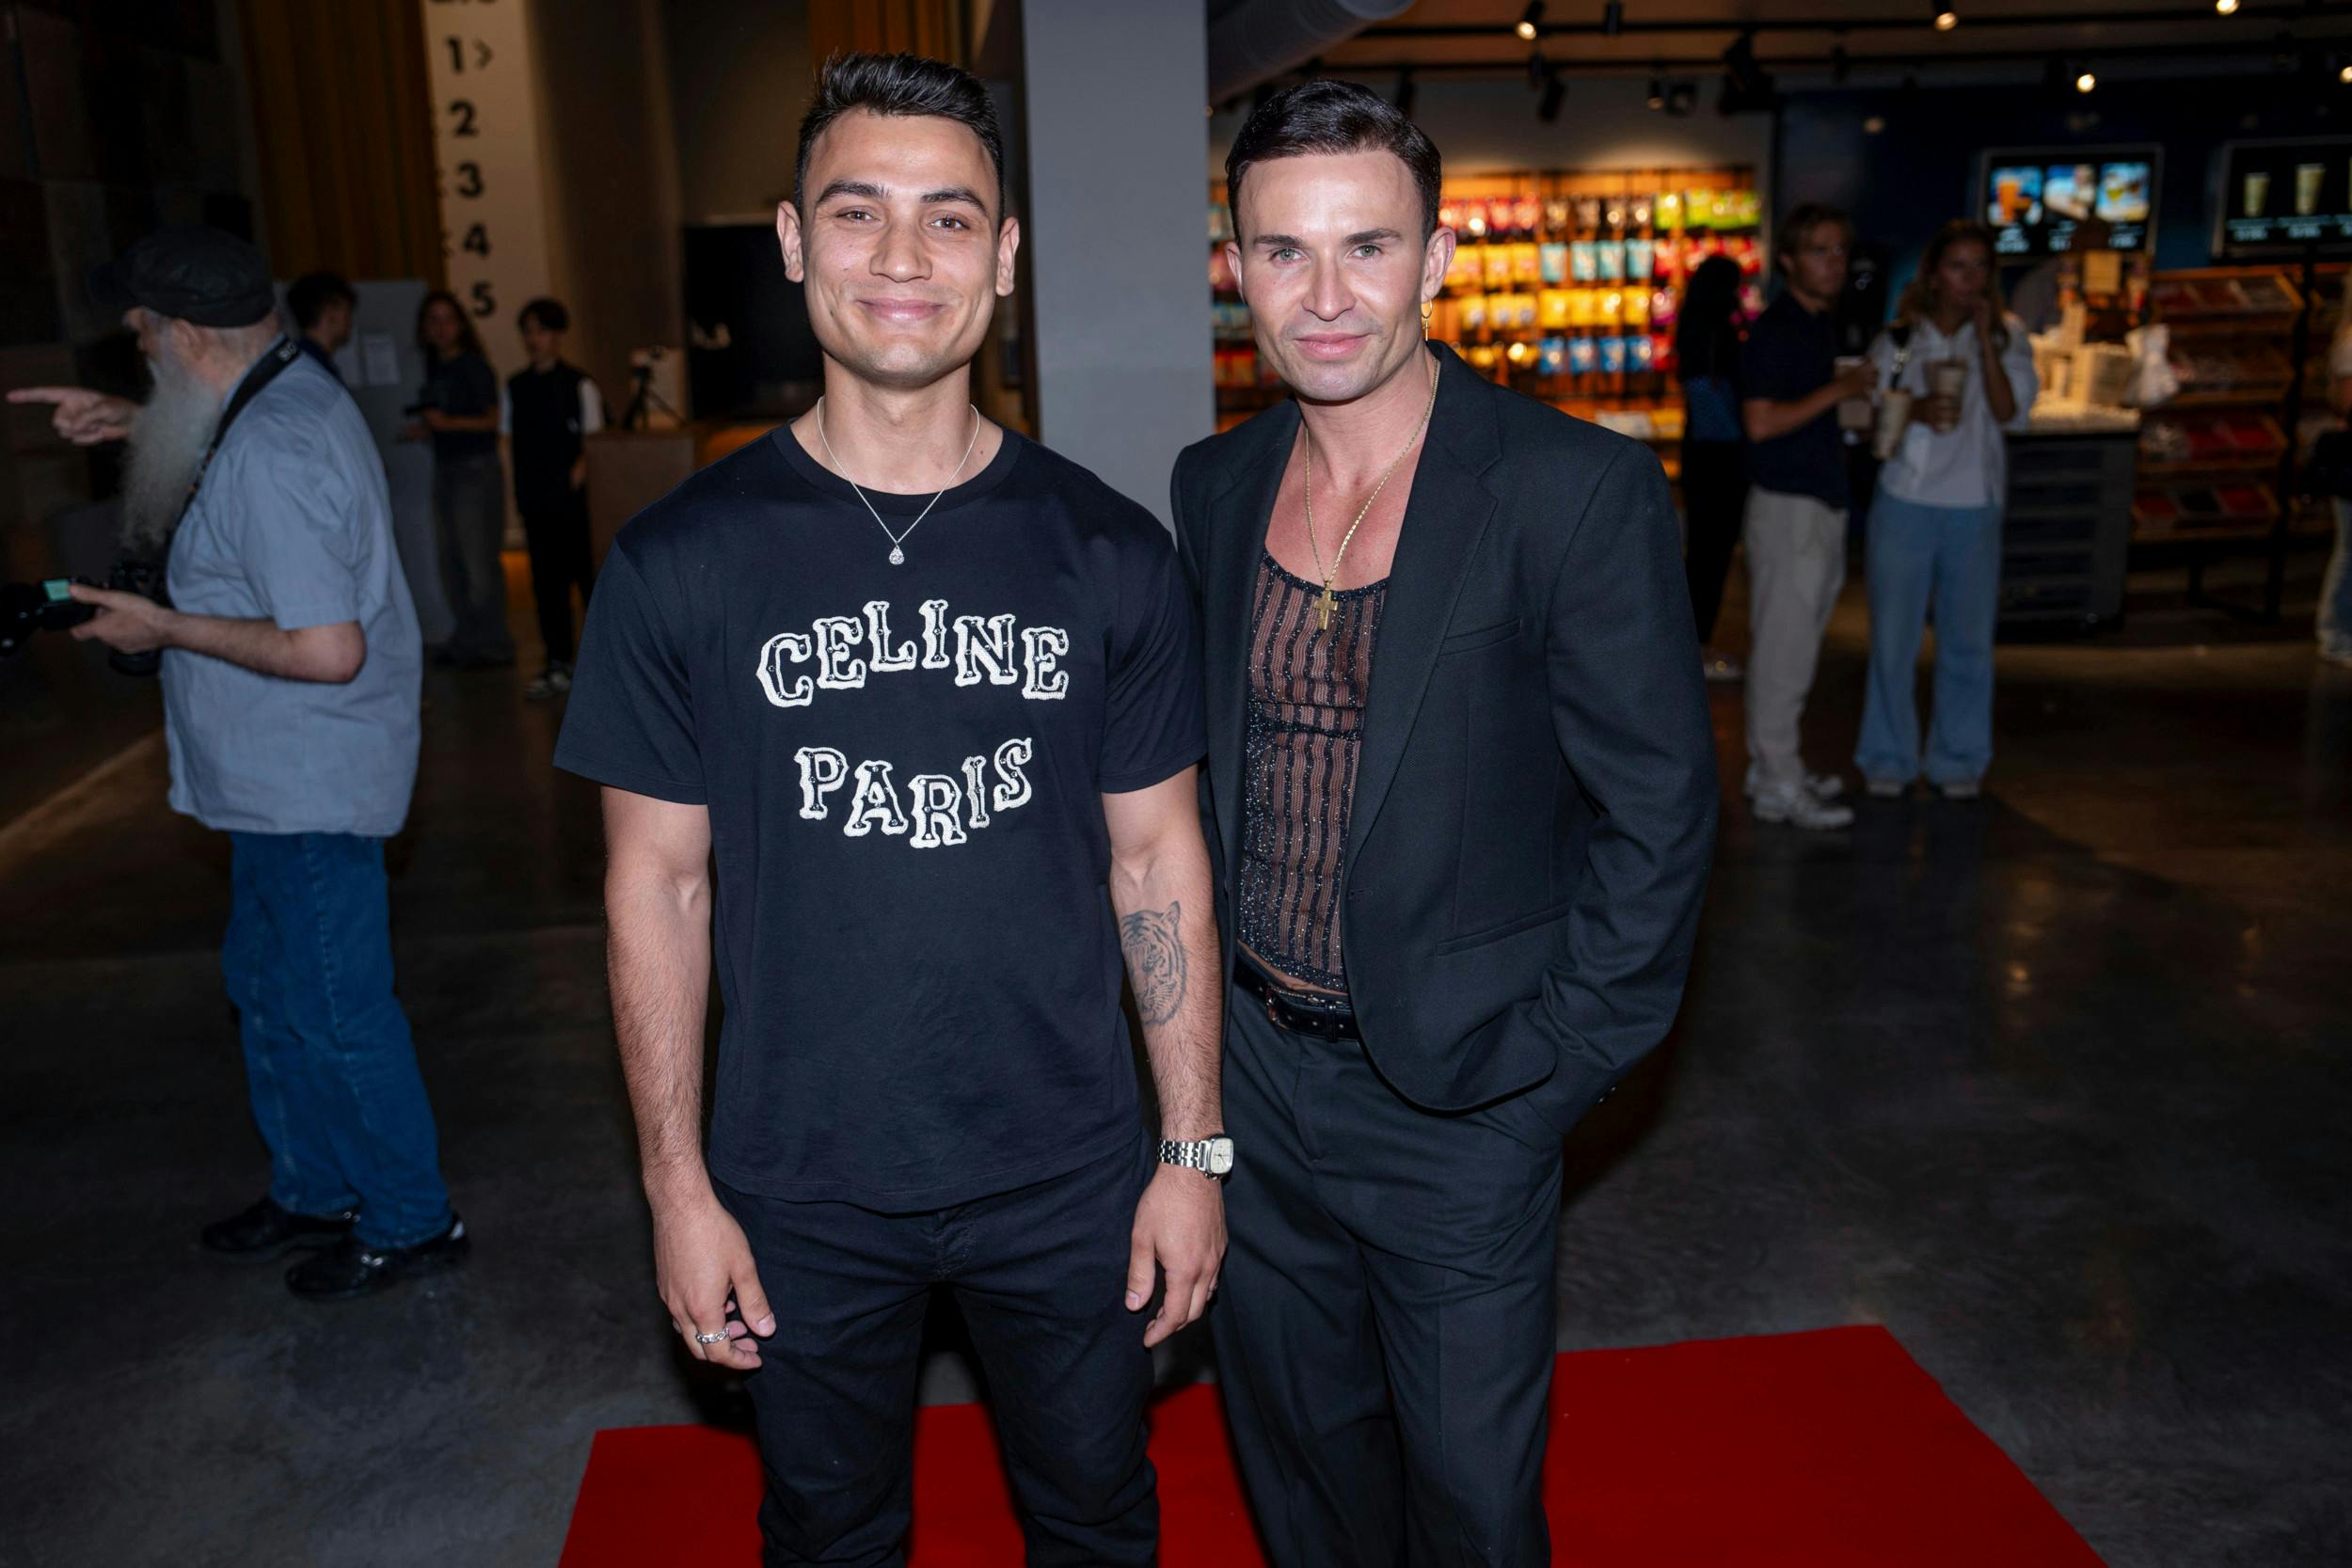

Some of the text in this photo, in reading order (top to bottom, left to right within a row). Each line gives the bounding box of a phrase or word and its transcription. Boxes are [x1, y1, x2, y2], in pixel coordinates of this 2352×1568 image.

[446, 36, 464, 73] 1
[449, 100, 477, 136] 2
[456, 162, 485, 198] 3
[462, 223, 490, 257] 4
[471, 283, 496, 318] 5
[755, 598, 1070, 708] CELINE
[793, 736, 1033, 849] PARIS
